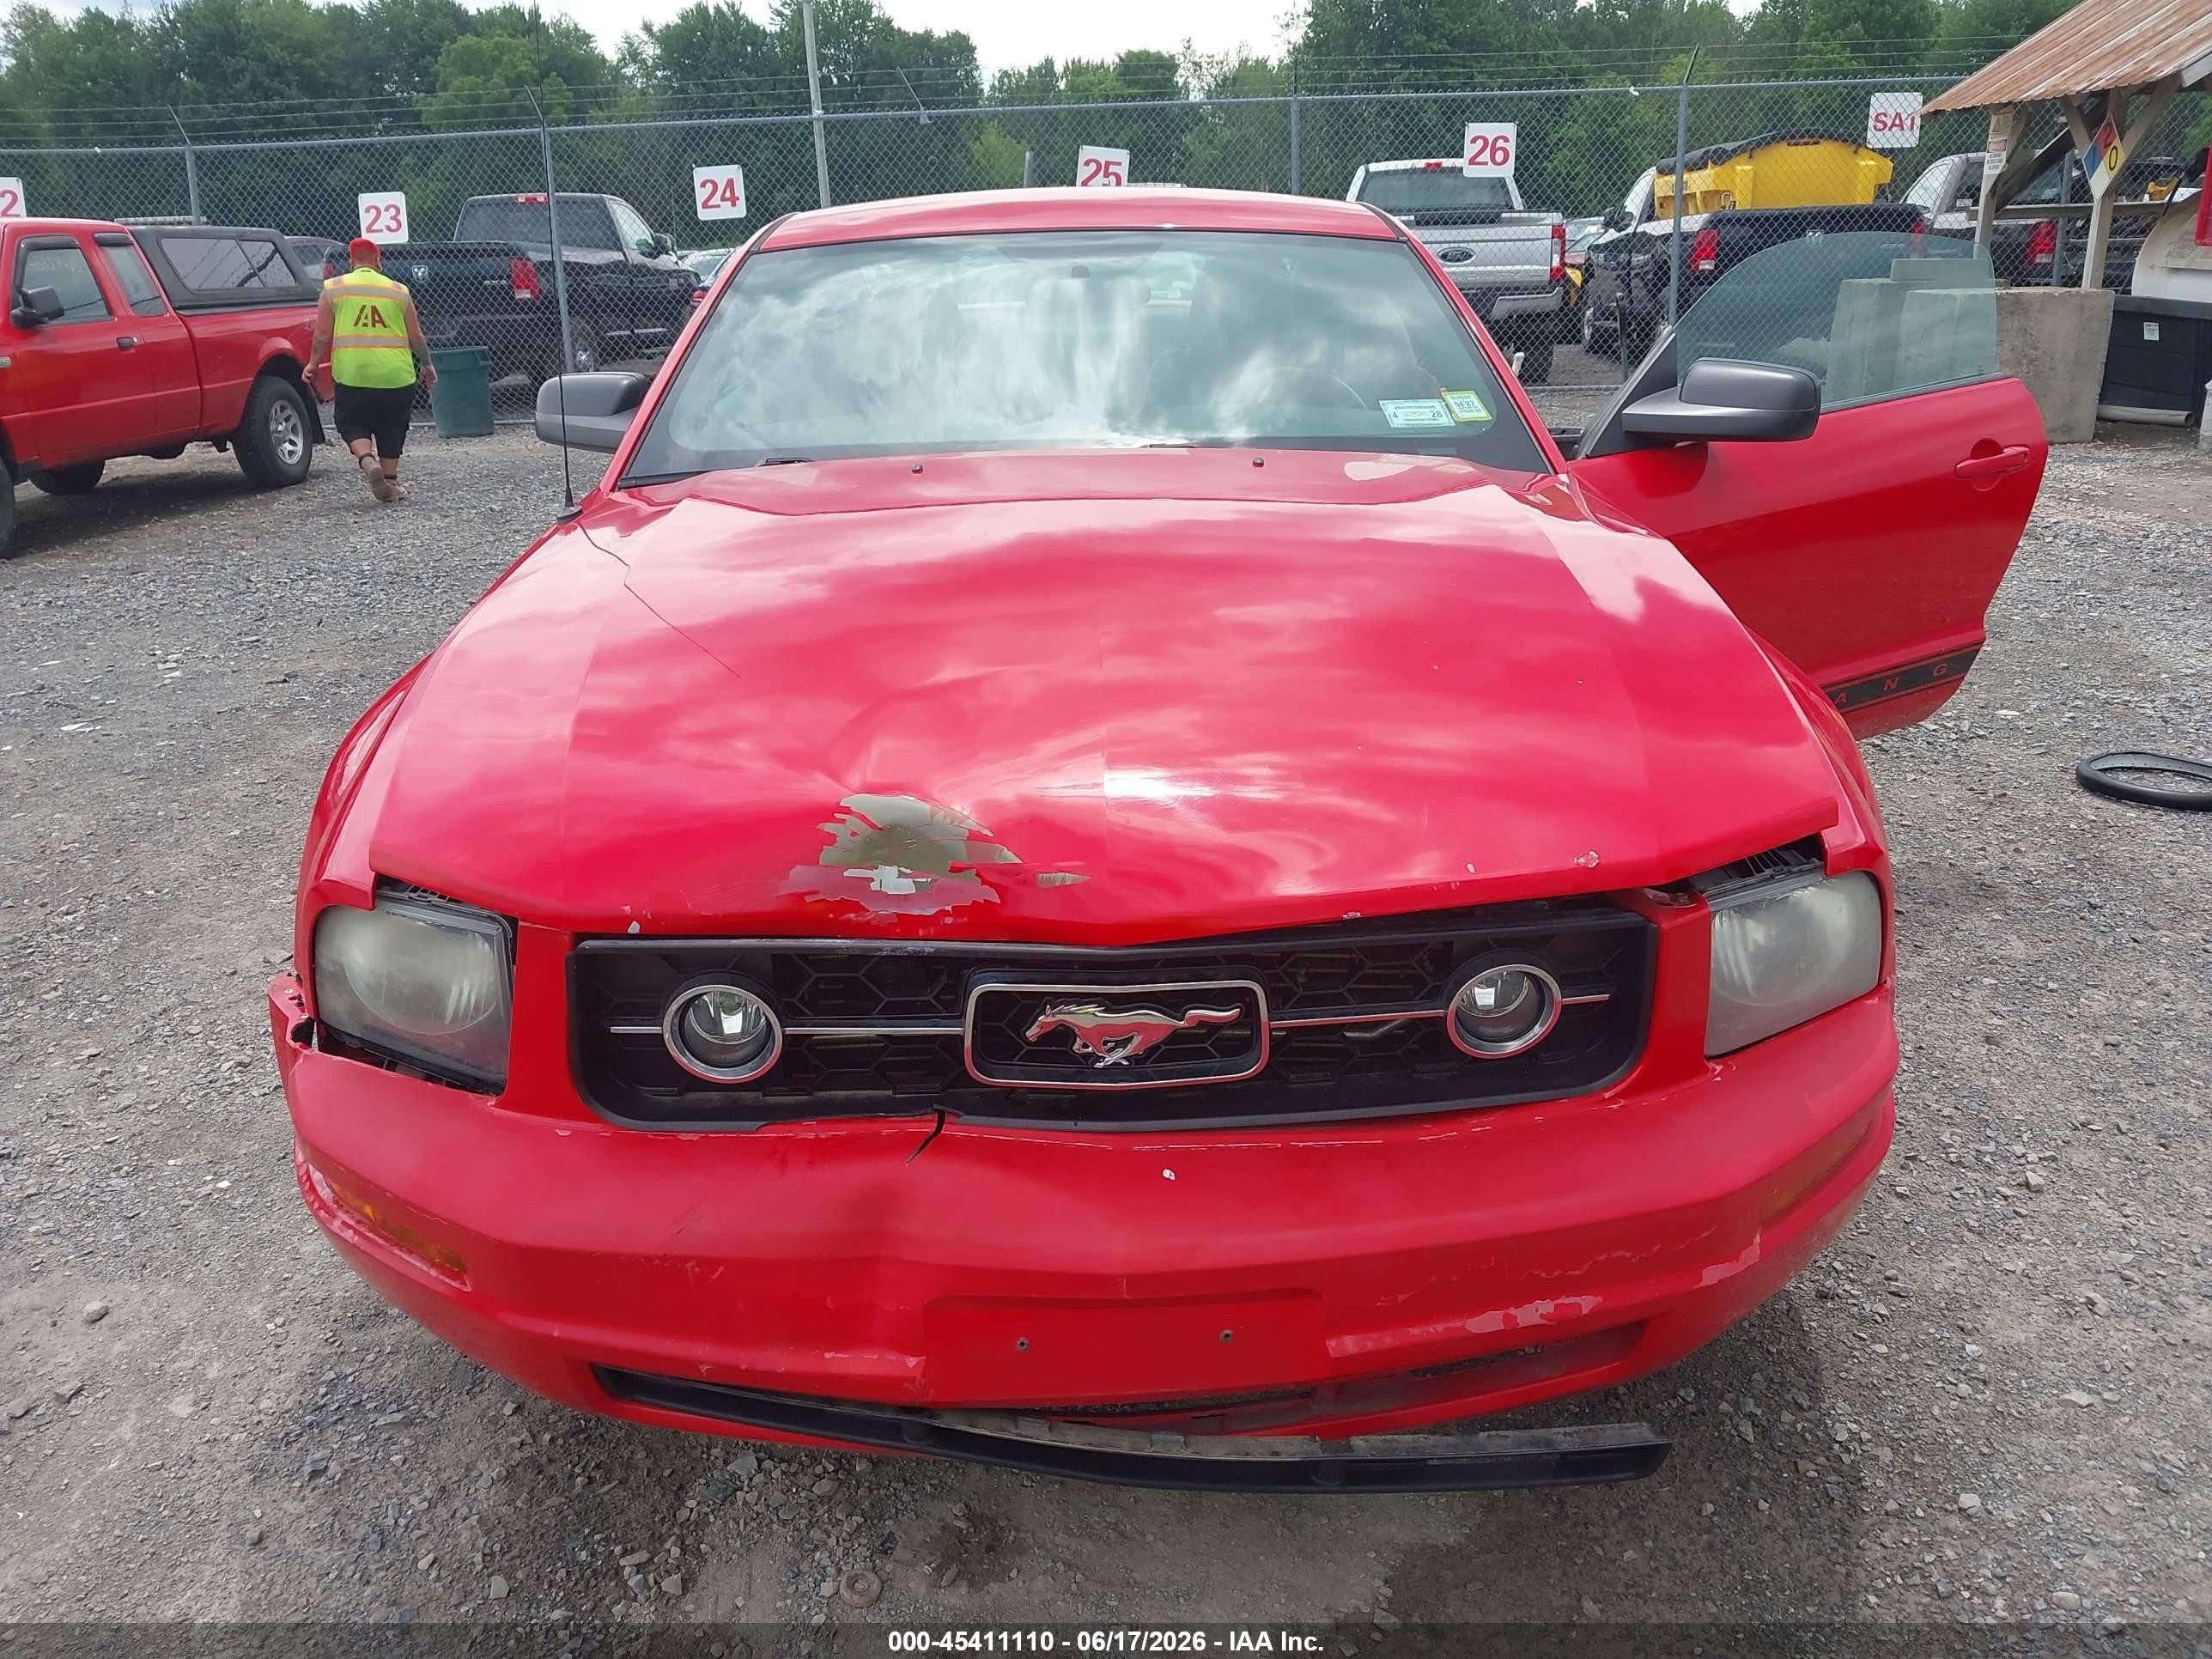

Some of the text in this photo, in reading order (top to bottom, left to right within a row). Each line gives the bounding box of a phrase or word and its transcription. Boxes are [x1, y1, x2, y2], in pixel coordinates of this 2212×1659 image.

[2103, 122, 2112, 149] 2
[1468, 135, 1510, 166] 26
[2108, 144, 2118, 172] 0
[1080, 158, 1122, 186] 25
[699, 178, 739, 209] 24
[364, 202, 403, 234] 23
